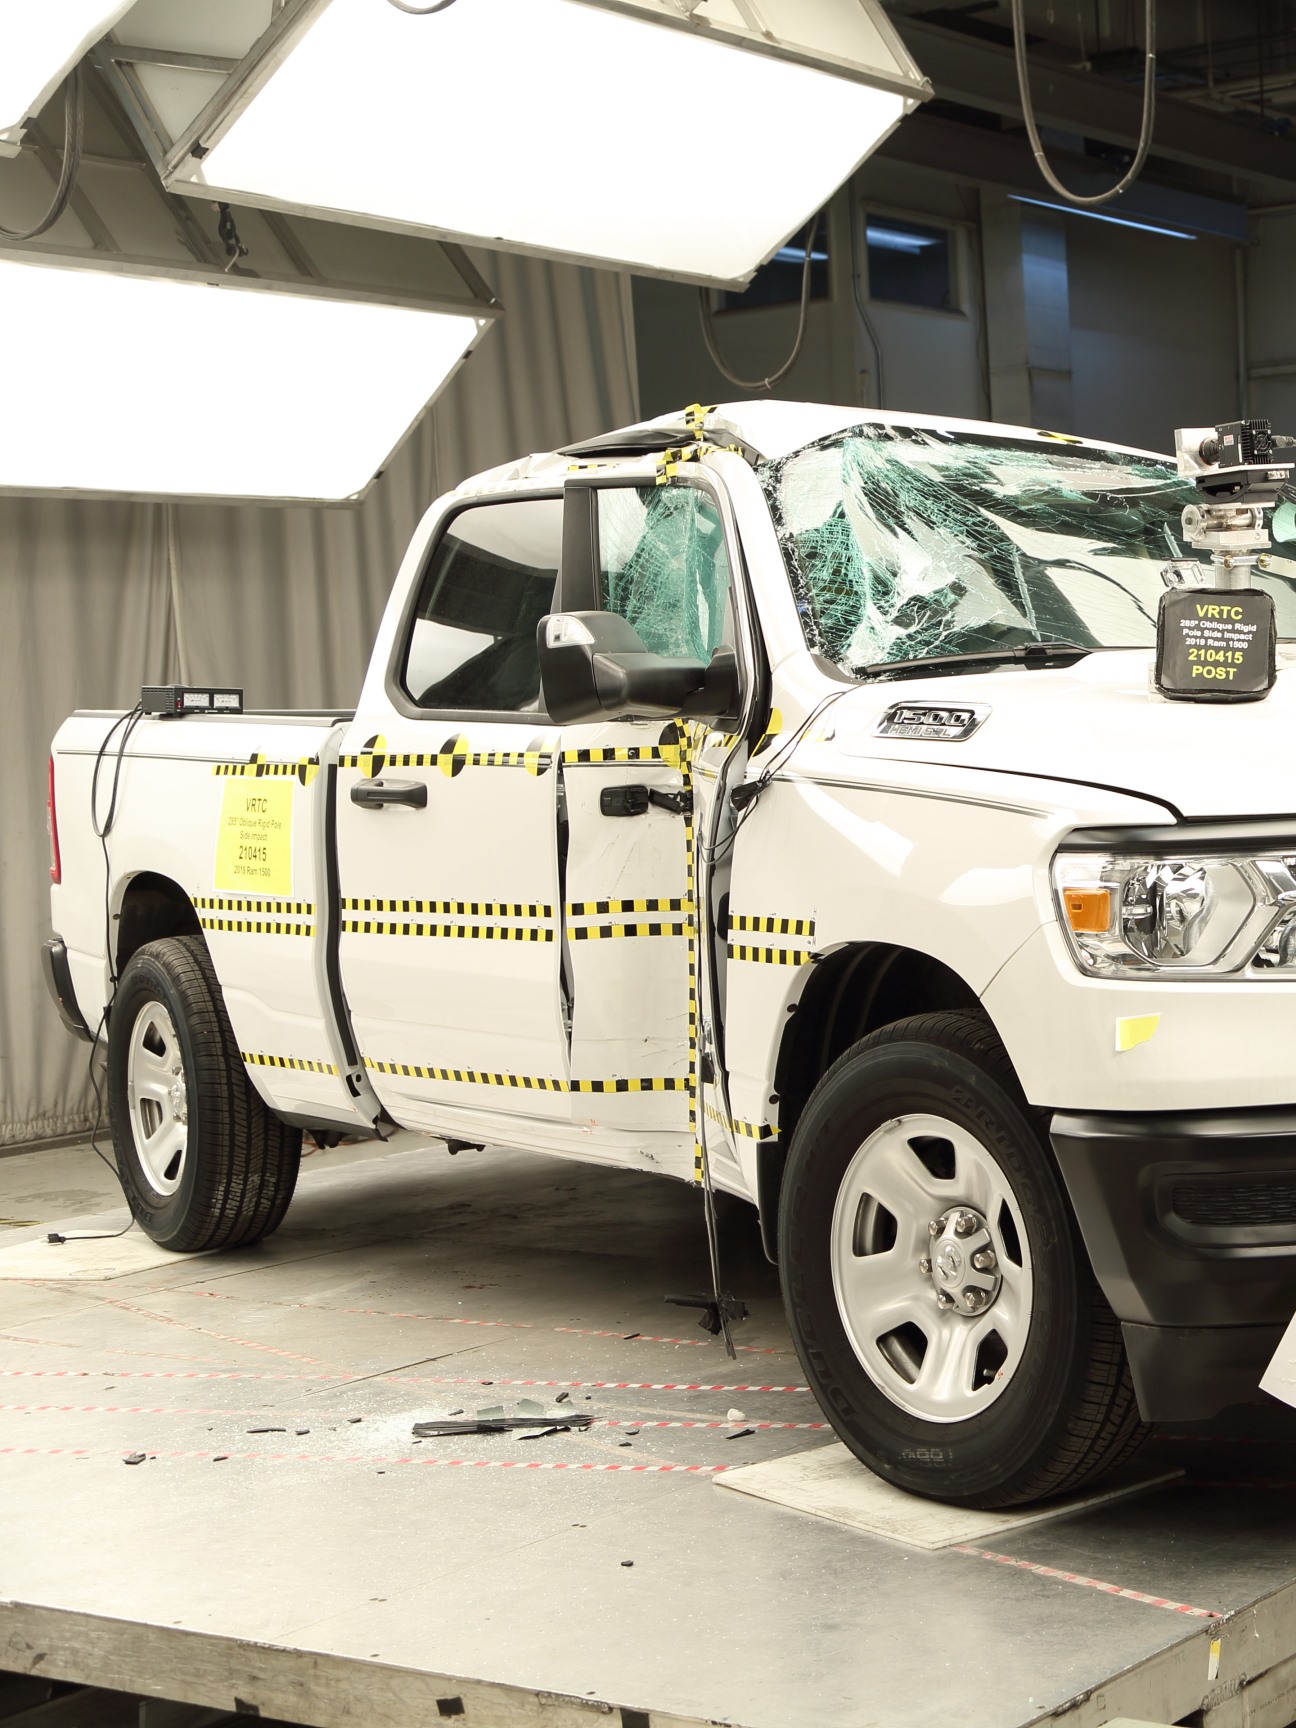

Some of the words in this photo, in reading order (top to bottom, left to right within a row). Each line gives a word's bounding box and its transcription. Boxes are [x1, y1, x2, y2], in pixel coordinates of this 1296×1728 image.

[1196, 604, 1243, 620] VRTC
[1200, 620, 1233, 630] Oblique
[1234, 623, 1257, 632] Rigid
[1183, 629, 1202, 637] Pole
[1203, 630, 1222, 638] Side
[1224, 631, 1253, 641] Impact
[1185, 638, 1206, 646] 2019
[1207, 639, 1227, 648] Ram
[1229, 641, 1249, 649] 1500
[1188, 648, 1244, 664] 210415
[1192, 665, 1237, 681] POST
[893, 708, 972, 727] 1500
[889, 725, 923, 737] HEMI
[246, 797, 268, 813] VRTC
[239, 817, 257, 828] Oblique
[258, 818, 271, 830] Rigid
[271, 819, 282, 830] Pole
[240, 830, 250, 840] Side
[251, 832, 268, 842] Impact
[239, 845, 267, 862] 210415
[247, 866, 258, 876] Ram
